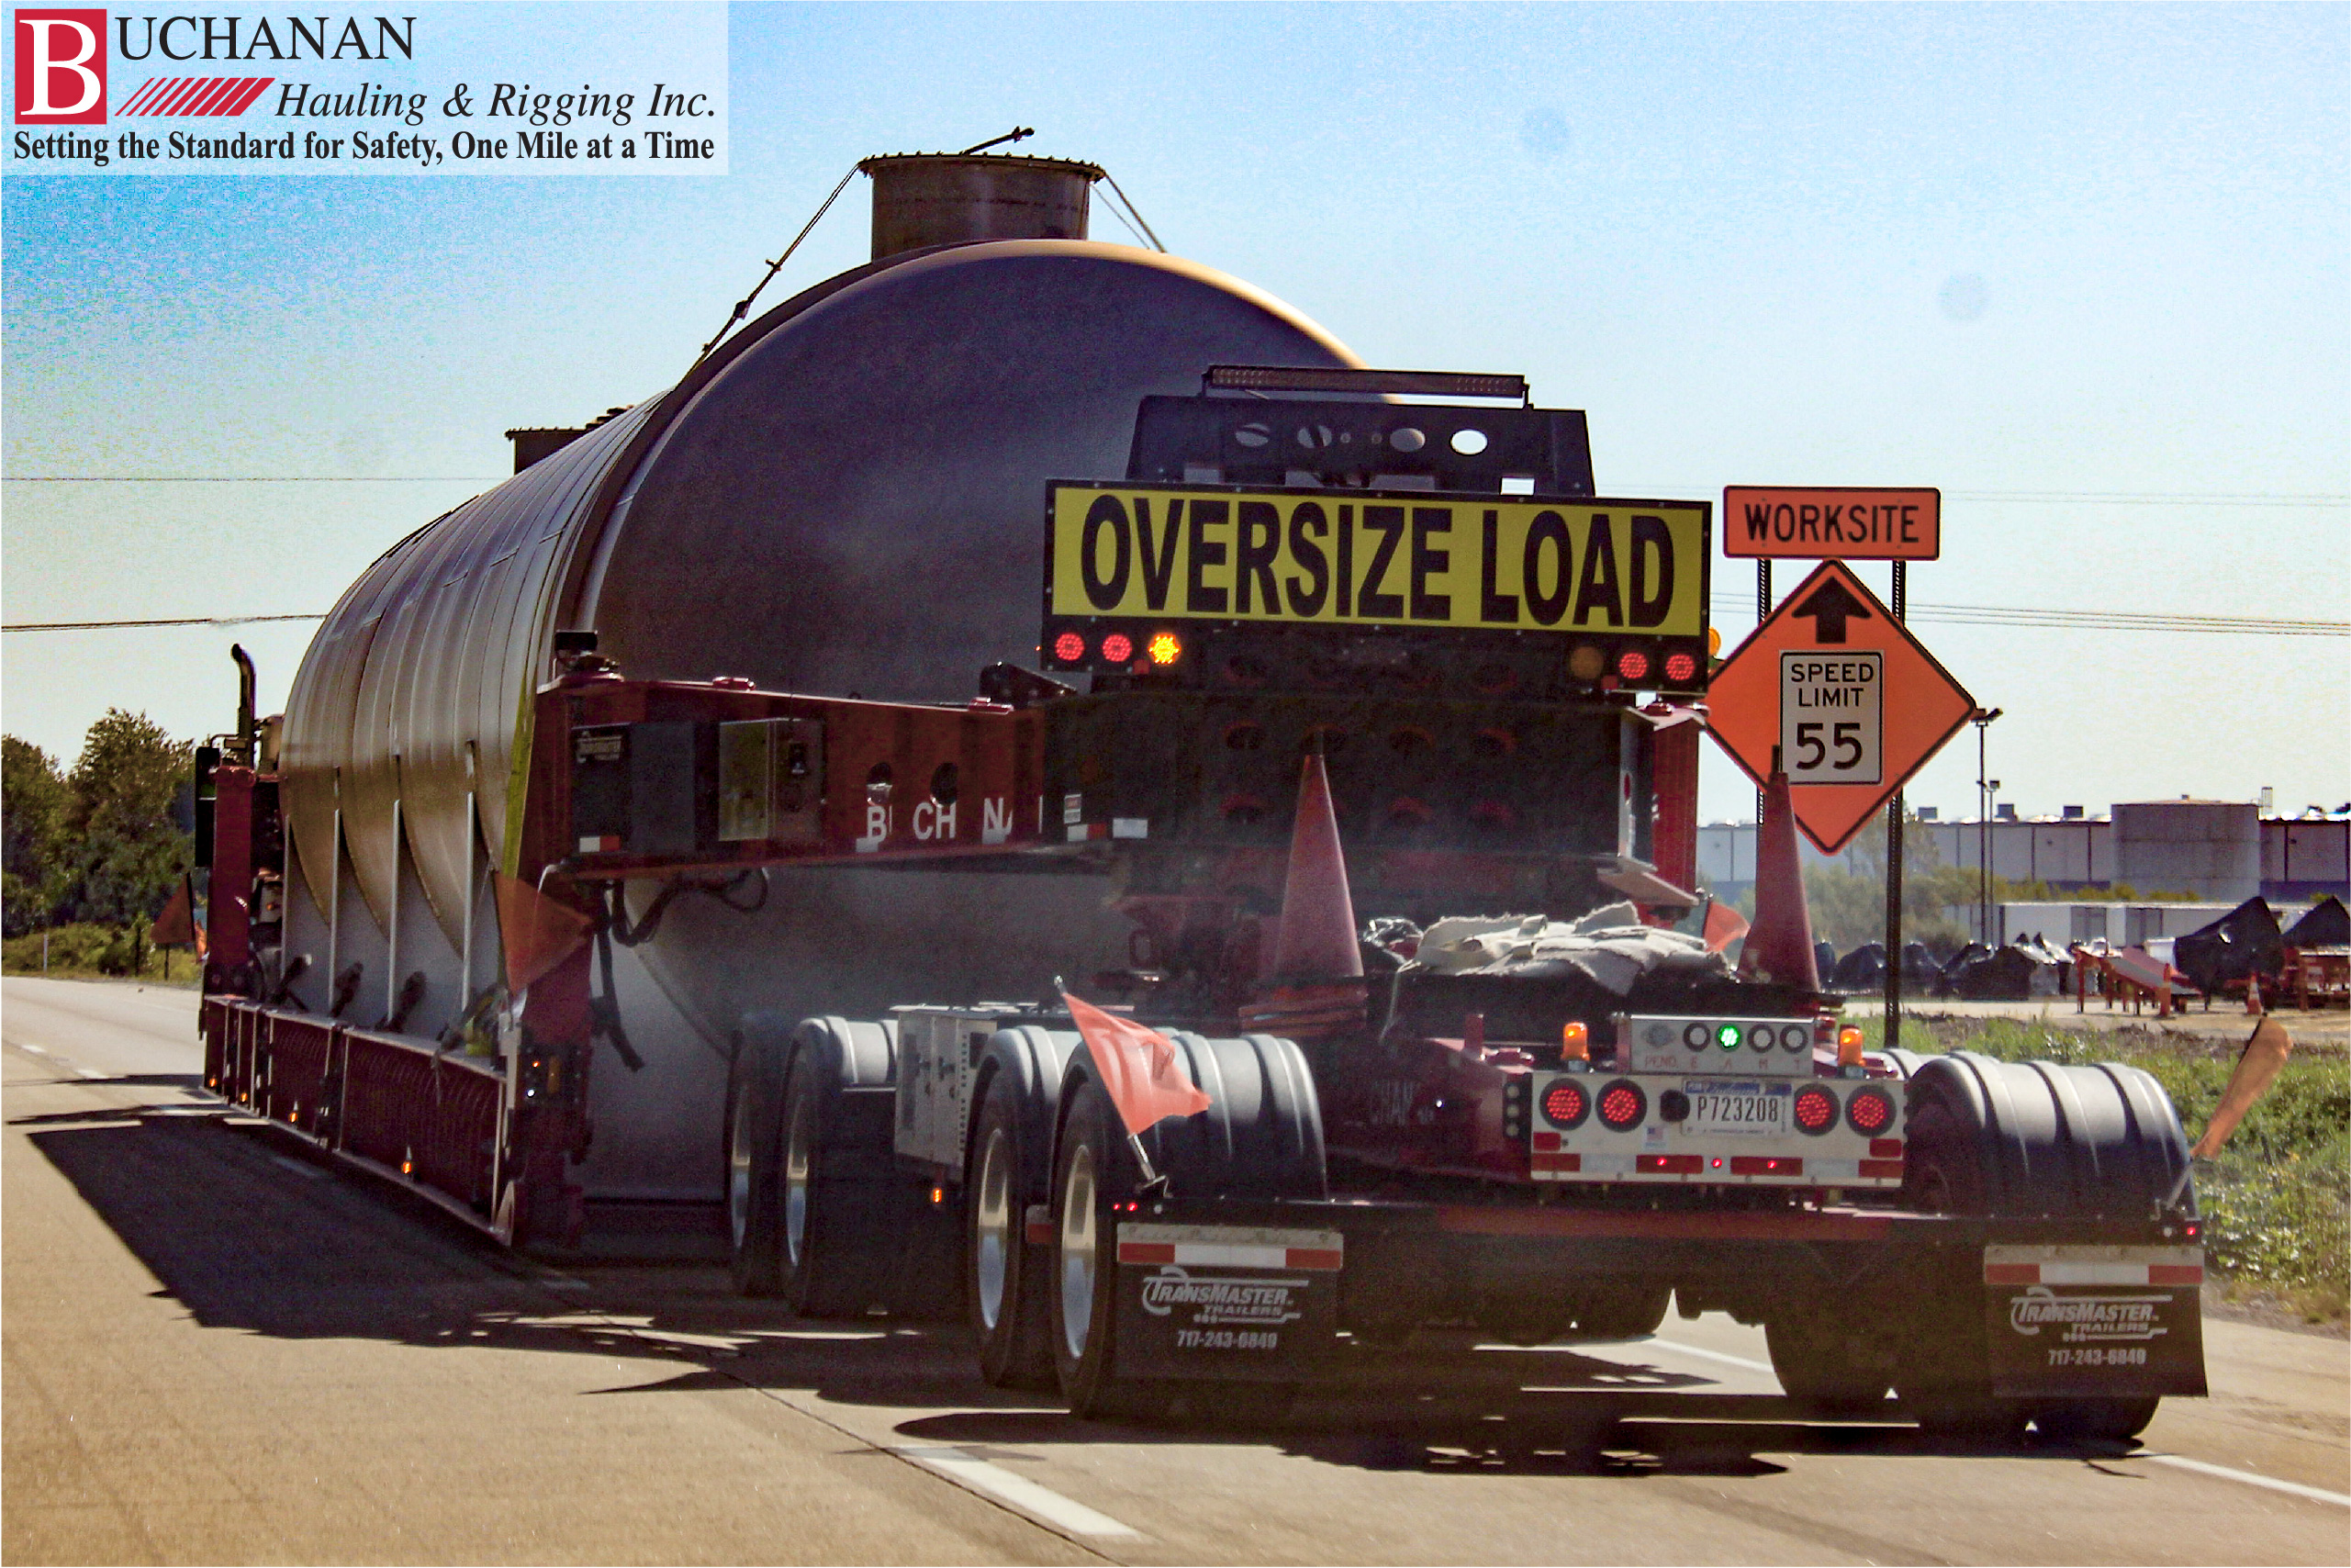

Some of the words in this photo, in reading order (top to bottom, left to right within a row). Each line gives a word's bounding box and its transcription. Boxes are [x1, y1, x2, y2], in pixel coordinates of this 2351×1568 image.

[1744, 503, 1920, 543] WORKSITE
[1080, 494, 1453, 622] OVERSIZE
[1480, 510, 1674, 628] LOAD
[1791, 662, 1875, 683] SPEED
[1798, 688, 1864, 708] LIMIT
[1797, 722, 1863, 770] 55
[1696, 1094, 1778, 1122] P723208
